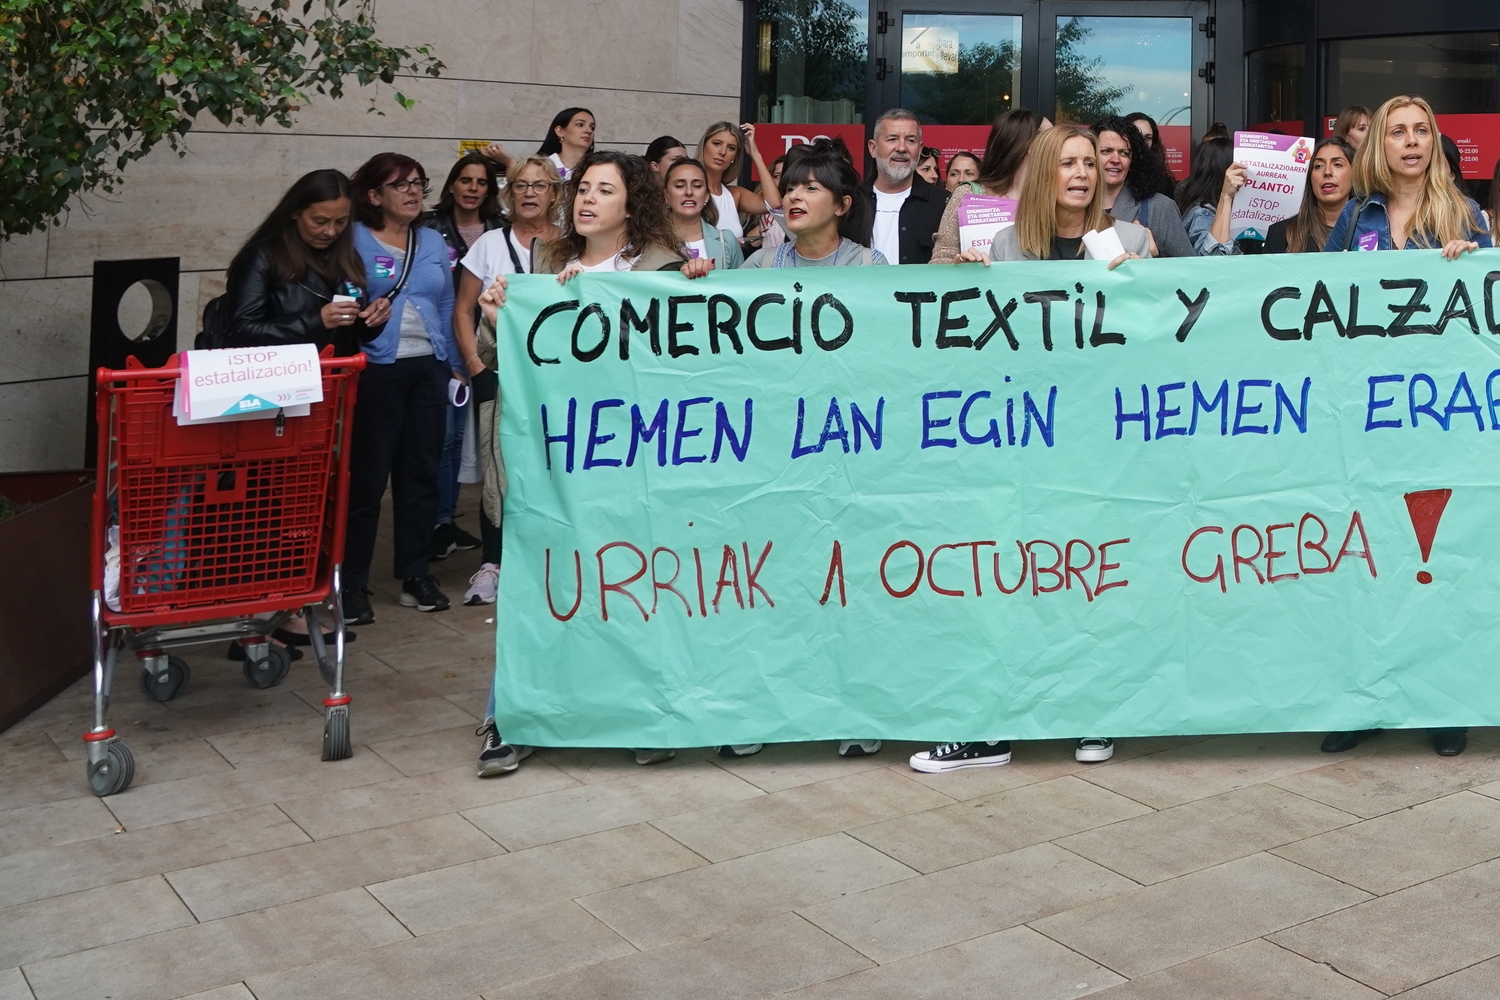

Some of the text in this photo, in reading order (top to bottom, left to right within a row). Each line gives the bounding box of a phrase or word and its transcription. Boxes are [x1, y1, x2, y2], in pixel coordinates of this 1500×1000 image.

[1256, 171, 1288, 180] AURREAN,
[1245, 180, 1294, 194] PLANTO!
[1248, 197, 1279, 211] ¡STOP
[972, 239, 993, 247] ESTA
[1174, 287, 1210, 343] Y
[227, 351, 278, 366] ¡STOP
[194, 359, 313, 387] estatalización!
[239, 398, 261, 409] ELA
[541, 397, 753, 474] HEMEN
[790, 396, 885, 460] LAN
[1114, 376, 1311, 441] HEMEN
[879, 537, 1131, 603] OCTUBRE
[1181, 509, 1378, 594] GREBA
